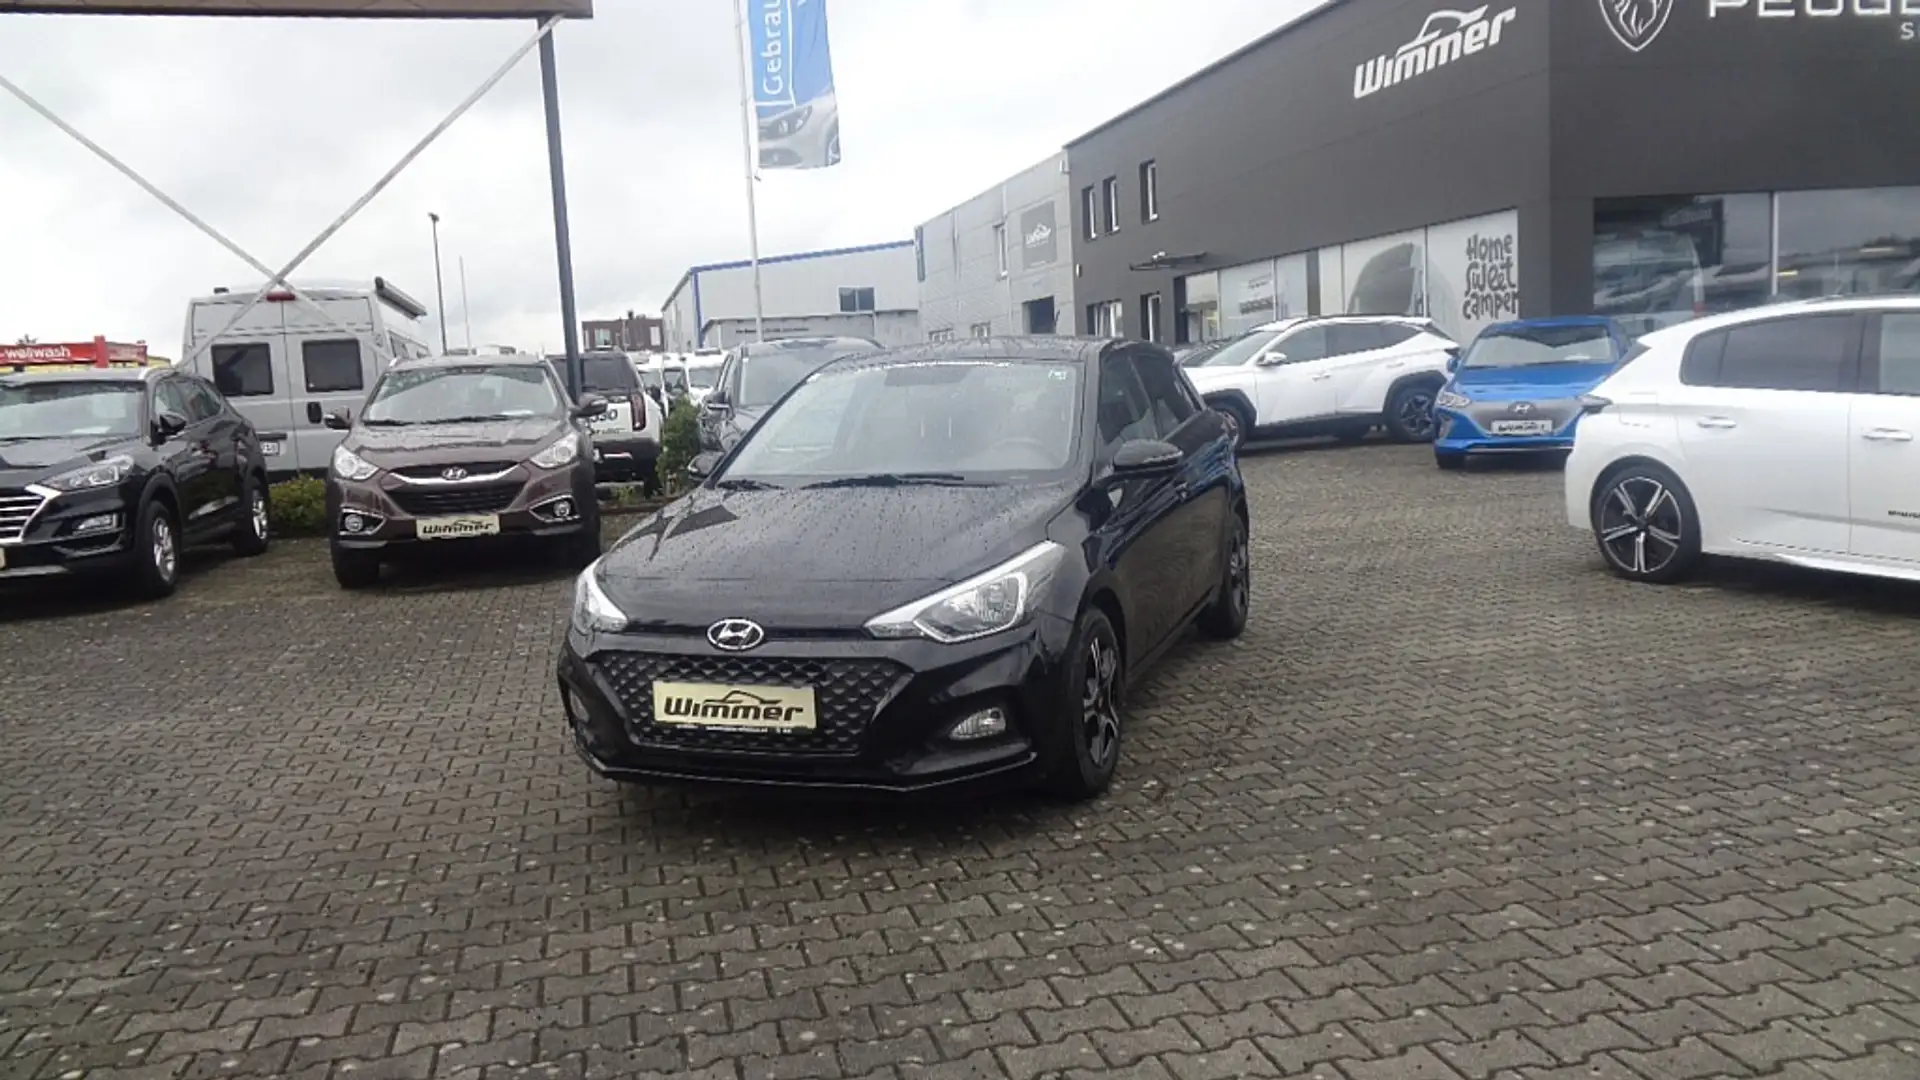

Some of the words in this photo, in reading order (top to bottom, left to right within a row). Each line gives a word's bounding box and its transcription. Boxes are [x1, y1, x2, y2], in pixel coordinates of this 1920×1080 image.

[1354, 7, 1516, 99] Wimmer
[1466, 233, 1513, 262] Home
[1465, 257, 1517, 297] Sweet
[664, 697, 804, 721] Wimmer
